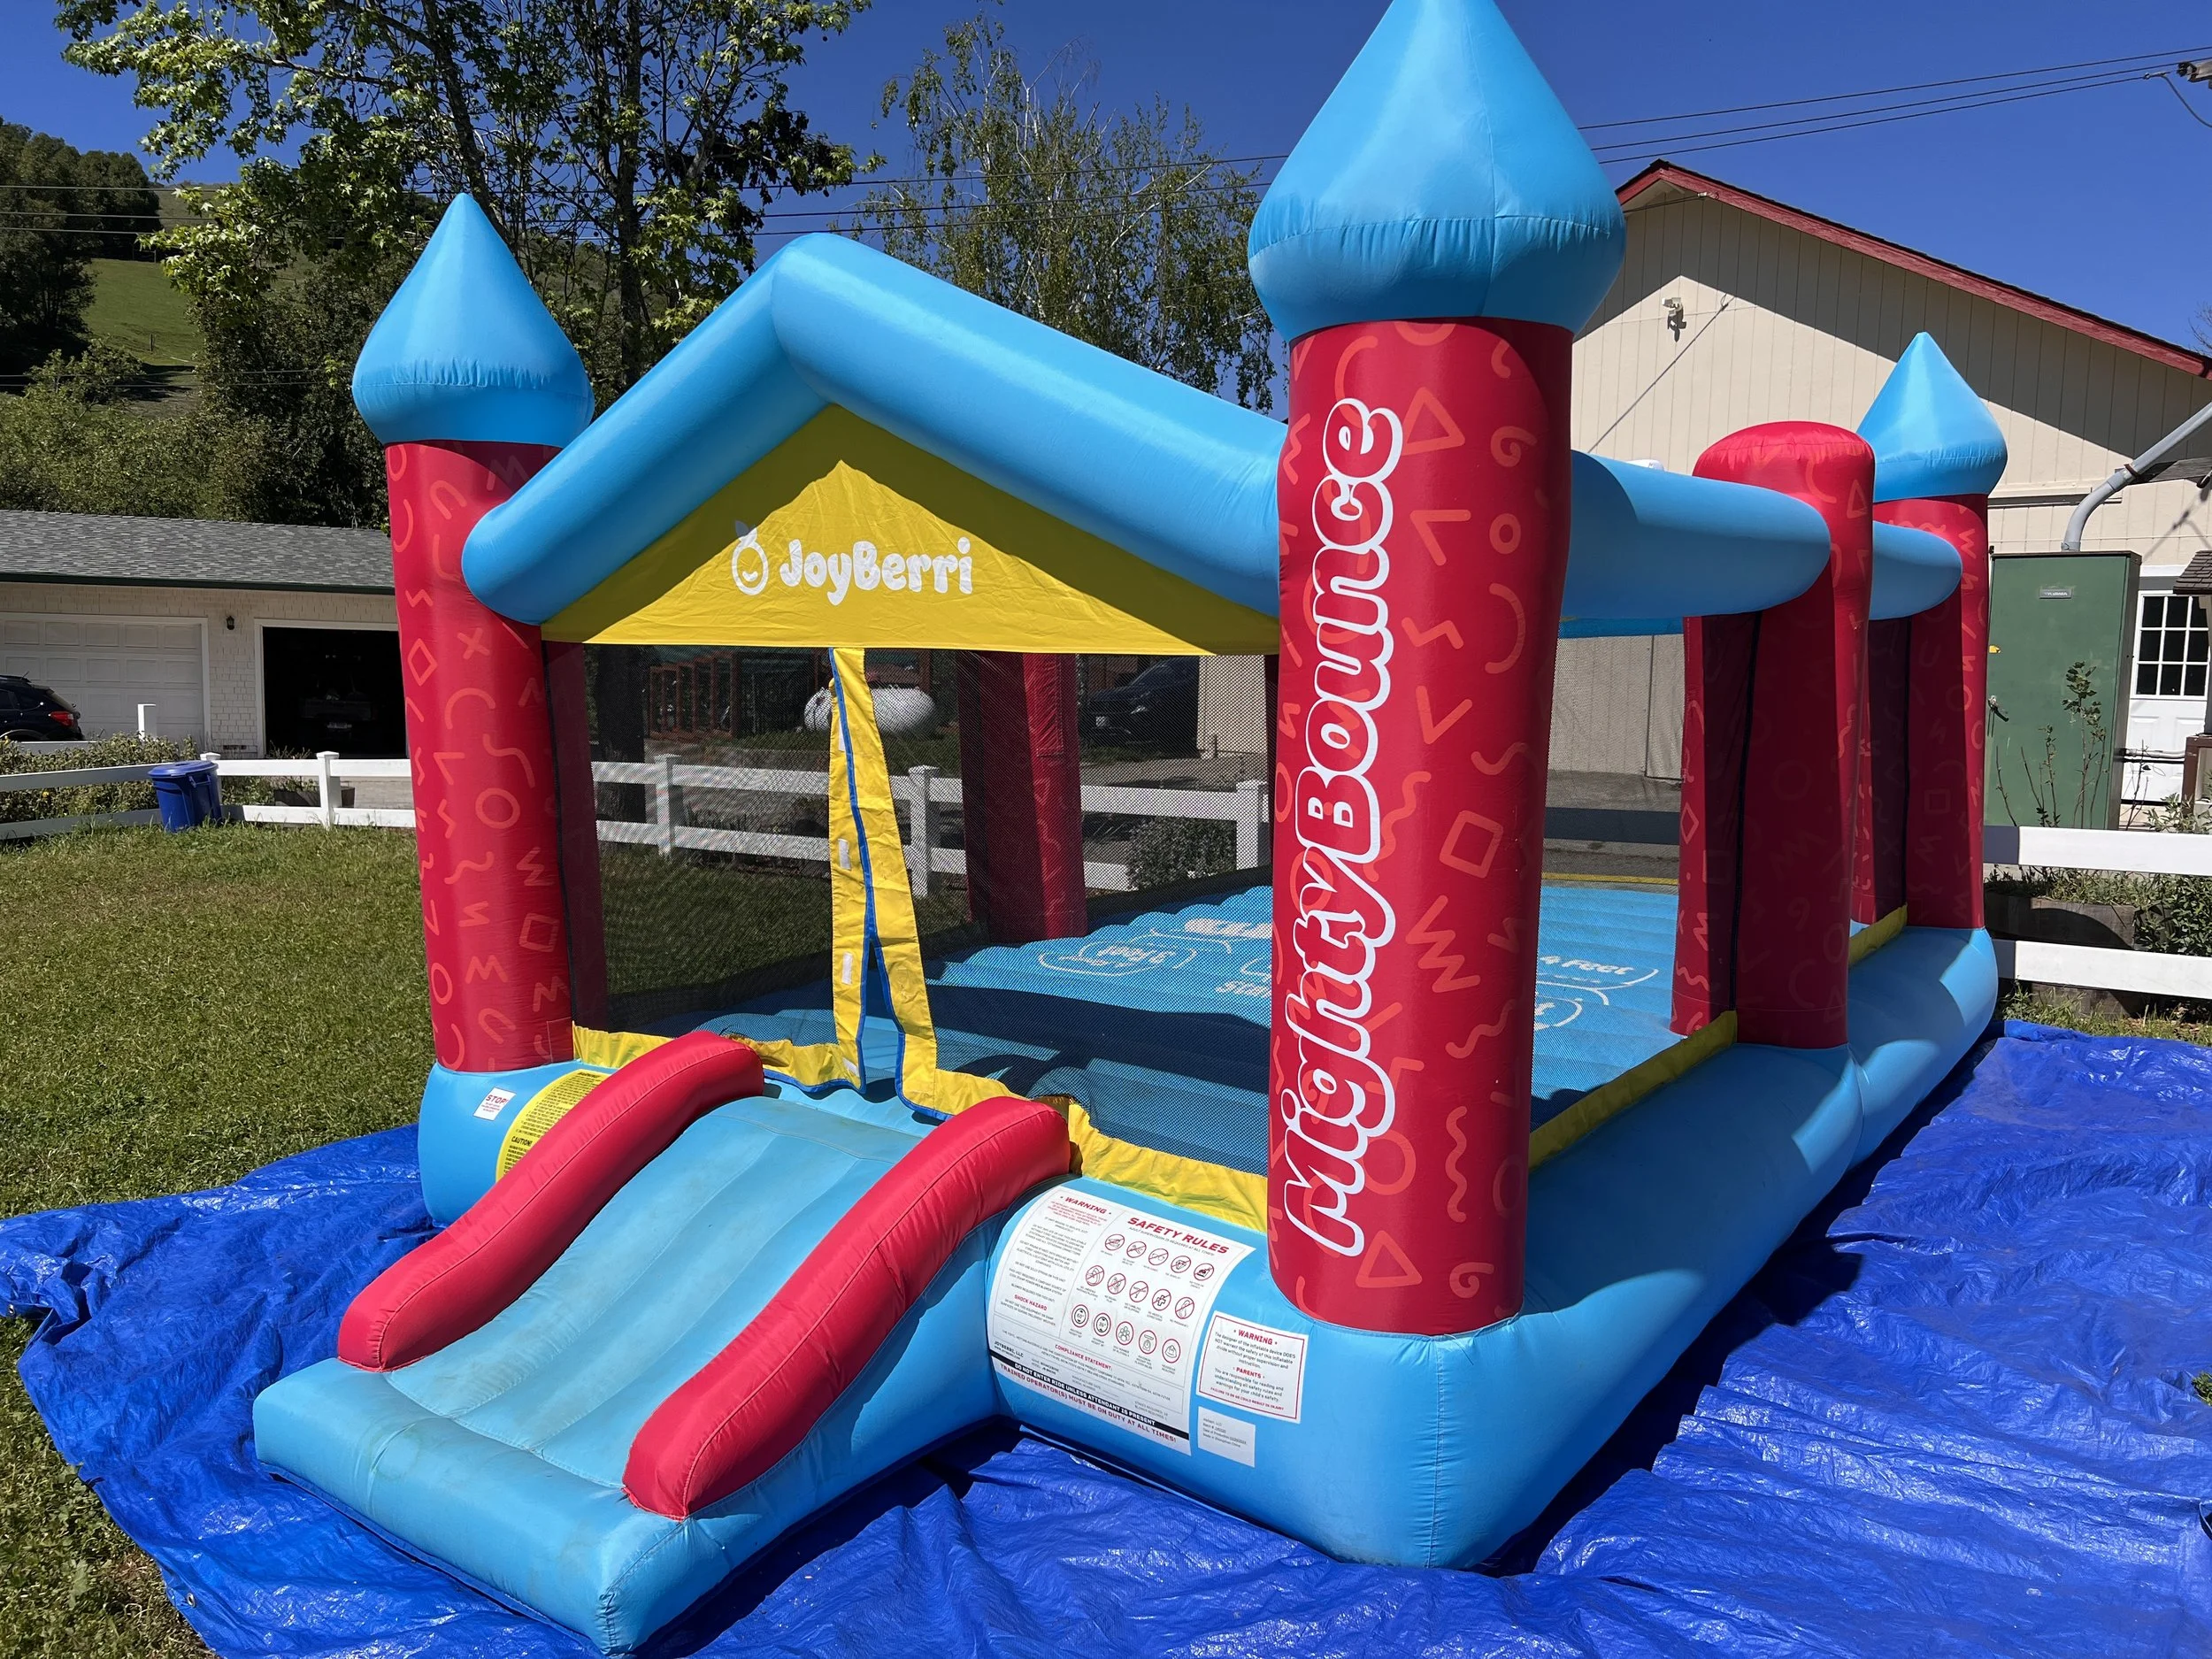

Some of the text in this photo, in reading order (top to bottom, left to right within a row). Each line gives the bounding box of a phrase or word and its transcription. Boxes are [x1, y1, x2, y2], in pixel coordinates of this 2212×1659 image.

[780, 536, 972, 606] JoyBerri
[1280, 396, 1404, 1257] MightyBounce
[1064, 1196, 1107, 1214] WARNING
[1127, 1217, 1229, 1254] SAFETY RULES
[1014, 1294, 1028, 1304] SHOCK
[1029, 1299, 1047, 1311] HAZARD
[1222, 1334, 1237, 1343] designer
[1250, 1342, 1269, 1352] inflatable
[1269, 1348, 1282, 1356] device
[1239, 1329, 1273, 1345] WARNING
[1055, 1344, 1084, 1359] COMPLIANCE
[1236, 1367, 1261, 1379] PARENTS
[1000, 1363, 1025, 1380] TRAINED
[1027, 1378, 1067, 1399] OPERATOR(S)
[1069, 1395, 1086, 1406] MUST
[1098, 1407, 1107, 1415] ON
[1108, 1411, 1125, 1422] DUTY
[1137, 1423, 1149, 1432] ALL
[1152, 1428, 1176, 1442] TIMES!
[1023, 1366, 1033, 1375] NOT
[1034, 1370, 1051, 1382] ENTER
[1052, 1378, 1065, 1389] RIDE
[1066, 1384, 1087, 1398] UNLESS
[1088, 1394, 1120, 1413] ATTENDANT
[1129, 1411, 1155, 1426] PRESENT
